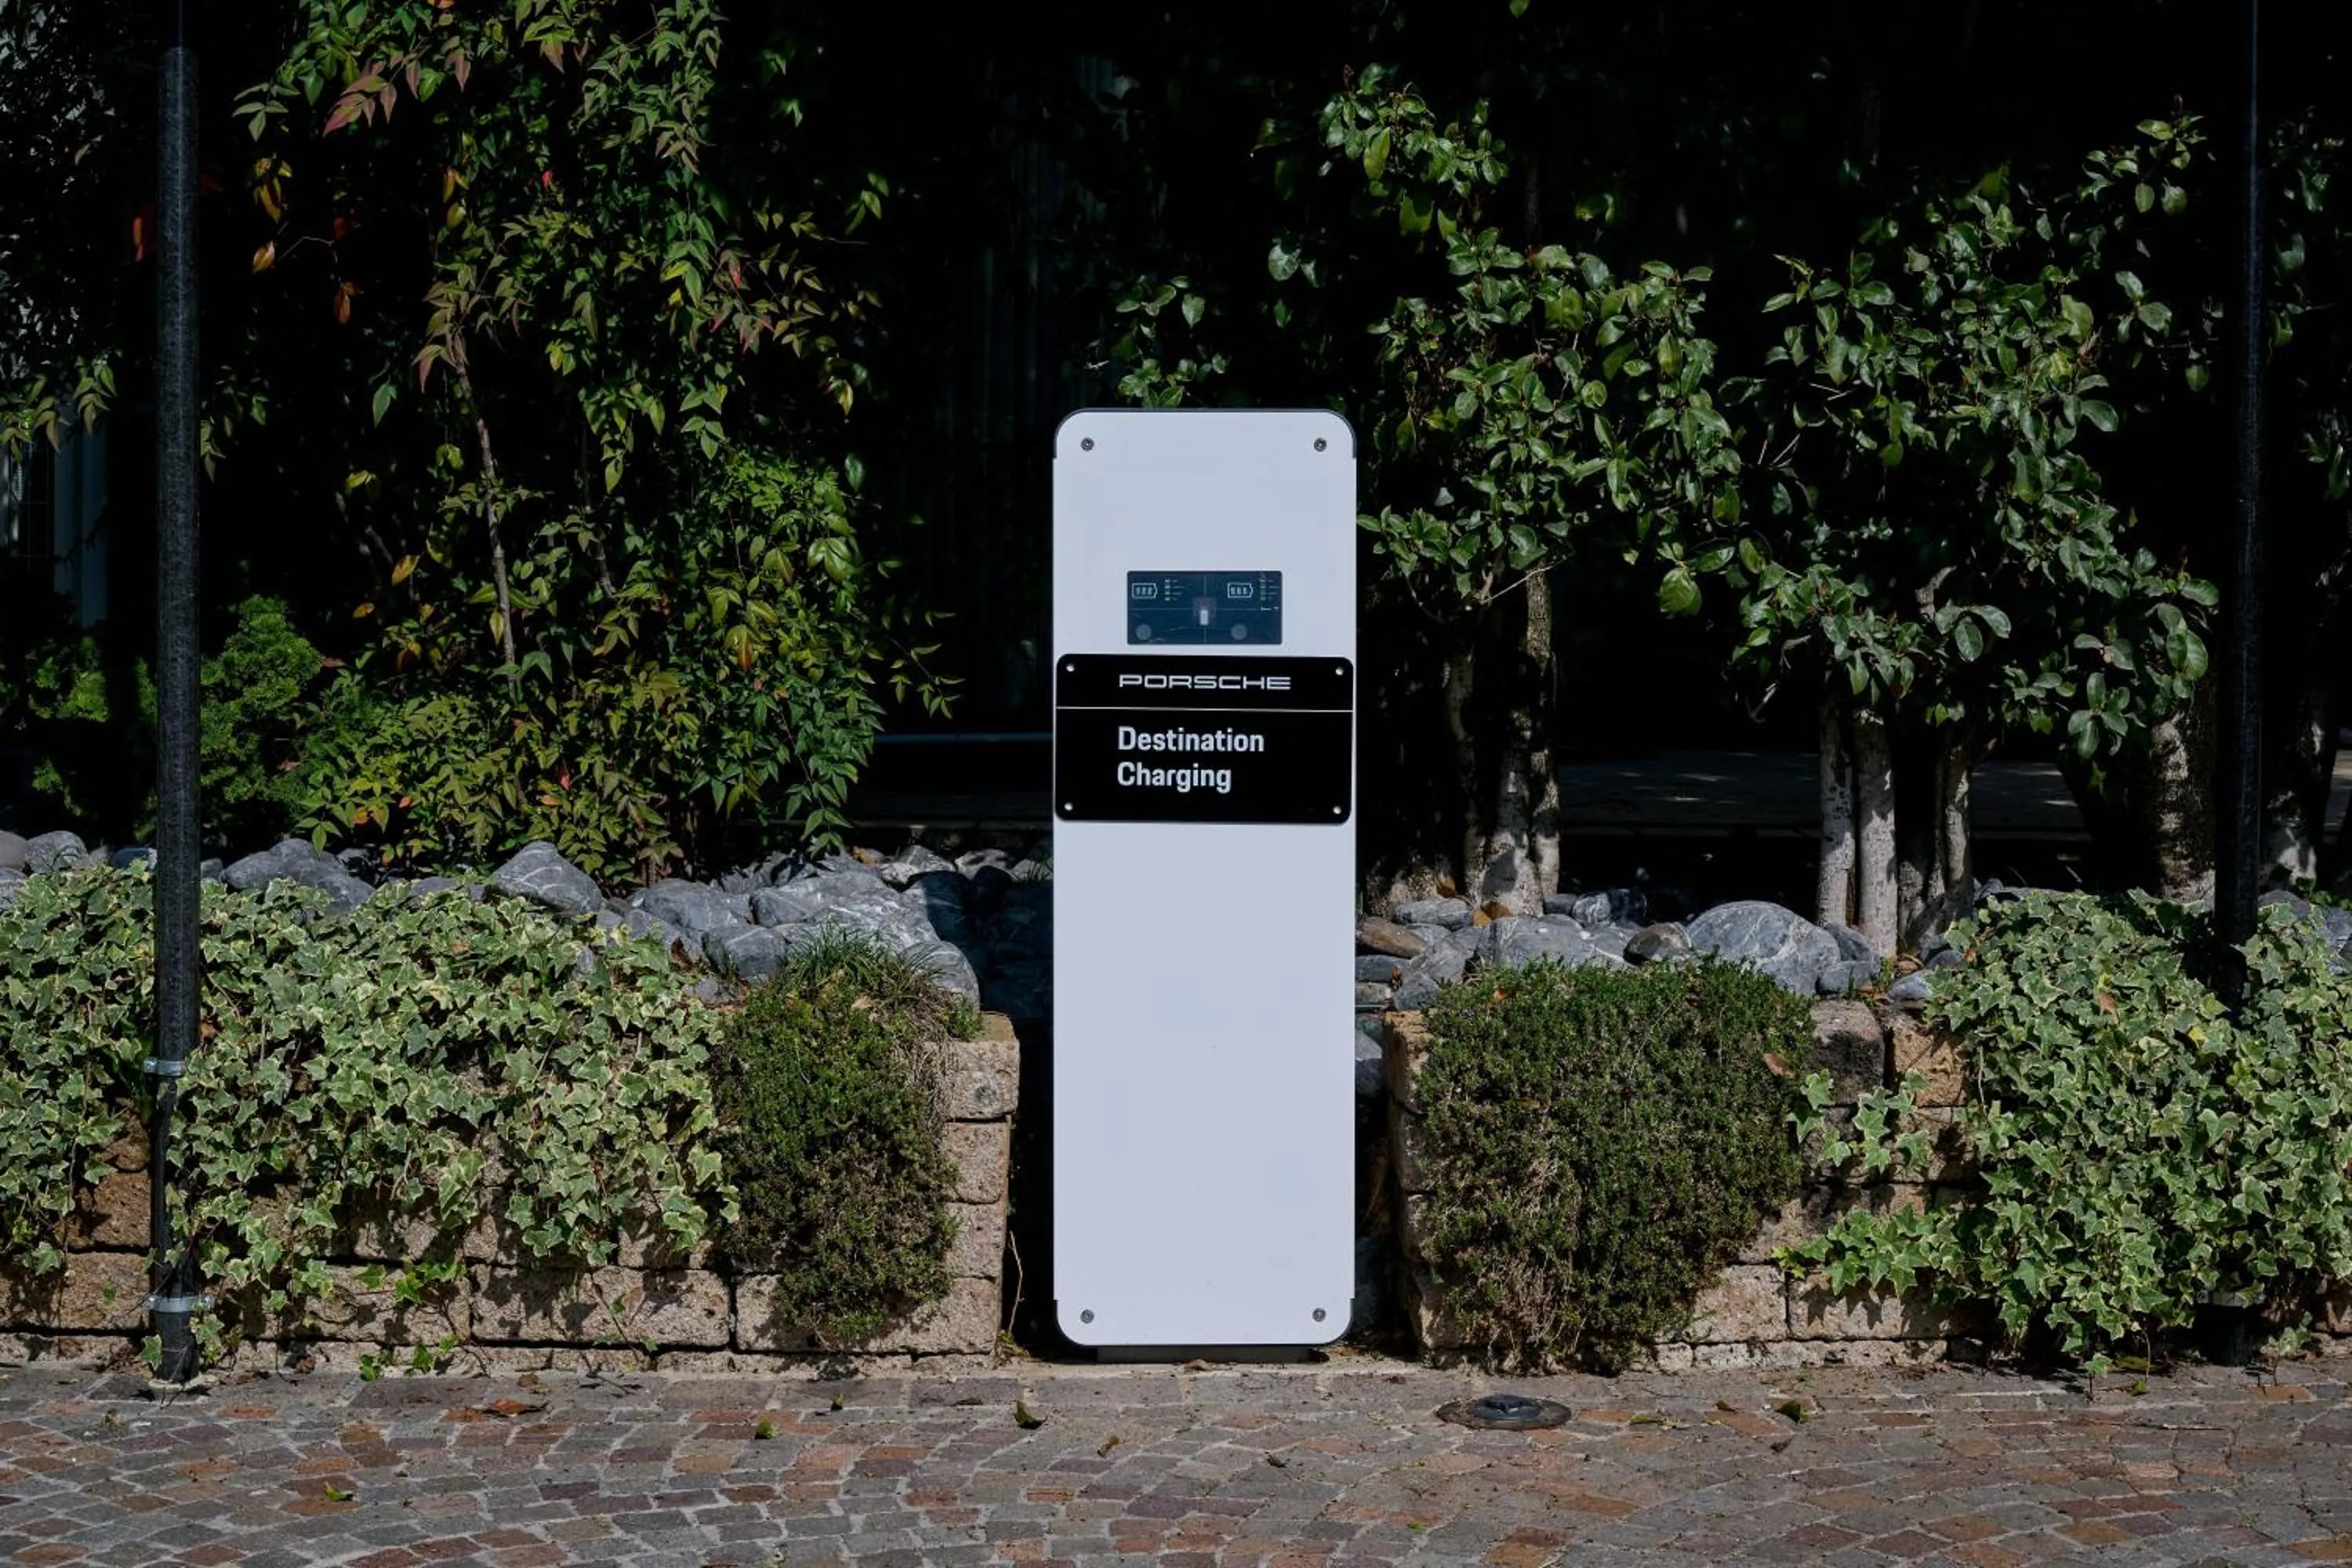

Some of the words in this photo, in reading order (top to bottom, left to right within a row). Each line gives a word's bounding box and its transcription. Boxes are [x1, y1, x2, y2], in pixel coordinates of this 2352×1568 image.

[1119, 674, 1291, 690] PORSCHE
[1118, 726, 1265, 752] Destination
[1117, 761, 1232, 793] Charging
